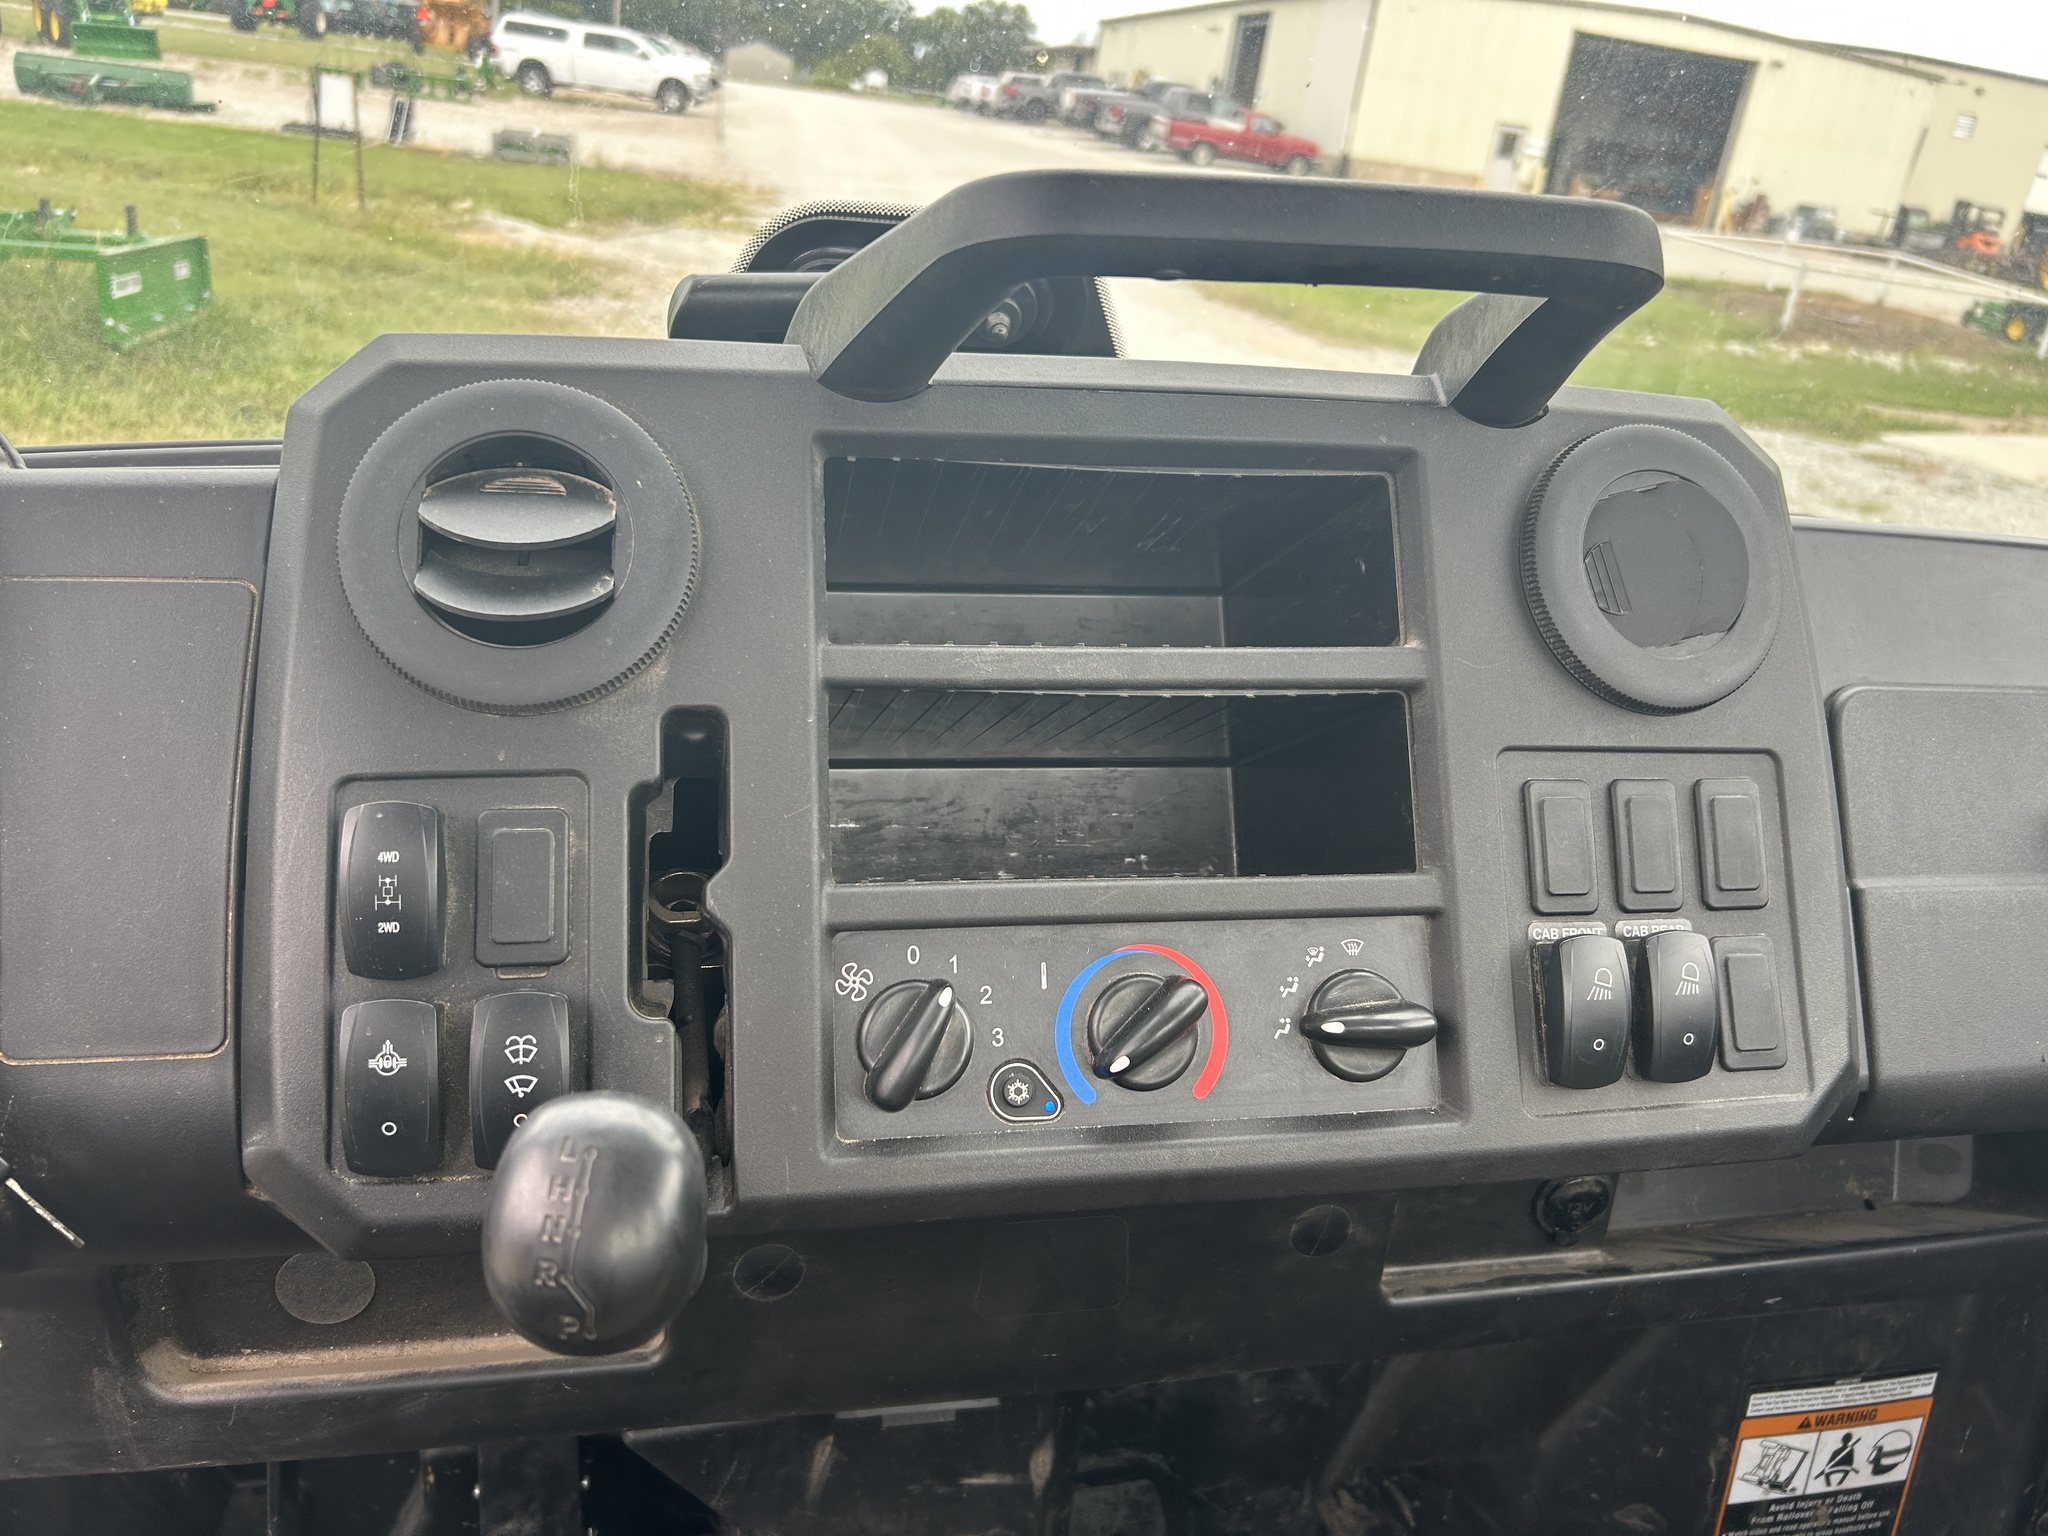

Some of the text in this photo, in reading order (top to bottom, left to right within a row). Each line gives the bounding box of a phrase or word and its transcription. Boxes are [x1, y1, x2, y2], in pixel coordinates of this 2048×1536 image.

[377, 851, 400, 863] 4WD
[377, 921, 400, 933] 2WD
[1532, 927, 1559, 940] CAB
[1623, 925, 1649, 938] CAB
[906, 945, 920, 965] 0
[949, 954, 958, 974] 1
[979, 985, 993, 1005] 2
[991, 1027, 1005, 1047] 3
[559, 1136, 577, 1163] L
[549, 1174, 576, 1202] H
[534, 1259, 558, 1288] R
[1814, 1408, 1878, 1427] WARNING
[1769, 1501, 1795, 1512] Avoid
[1797, 1499, 1823, 1509] Injury
[1836, 1491, 1863, 1503] Death
[1750, 1515, 1775, 1526] From
[1776, 1509, 1816, 1521] Rollover
[1860, 1500, 1876, 1510] Off
